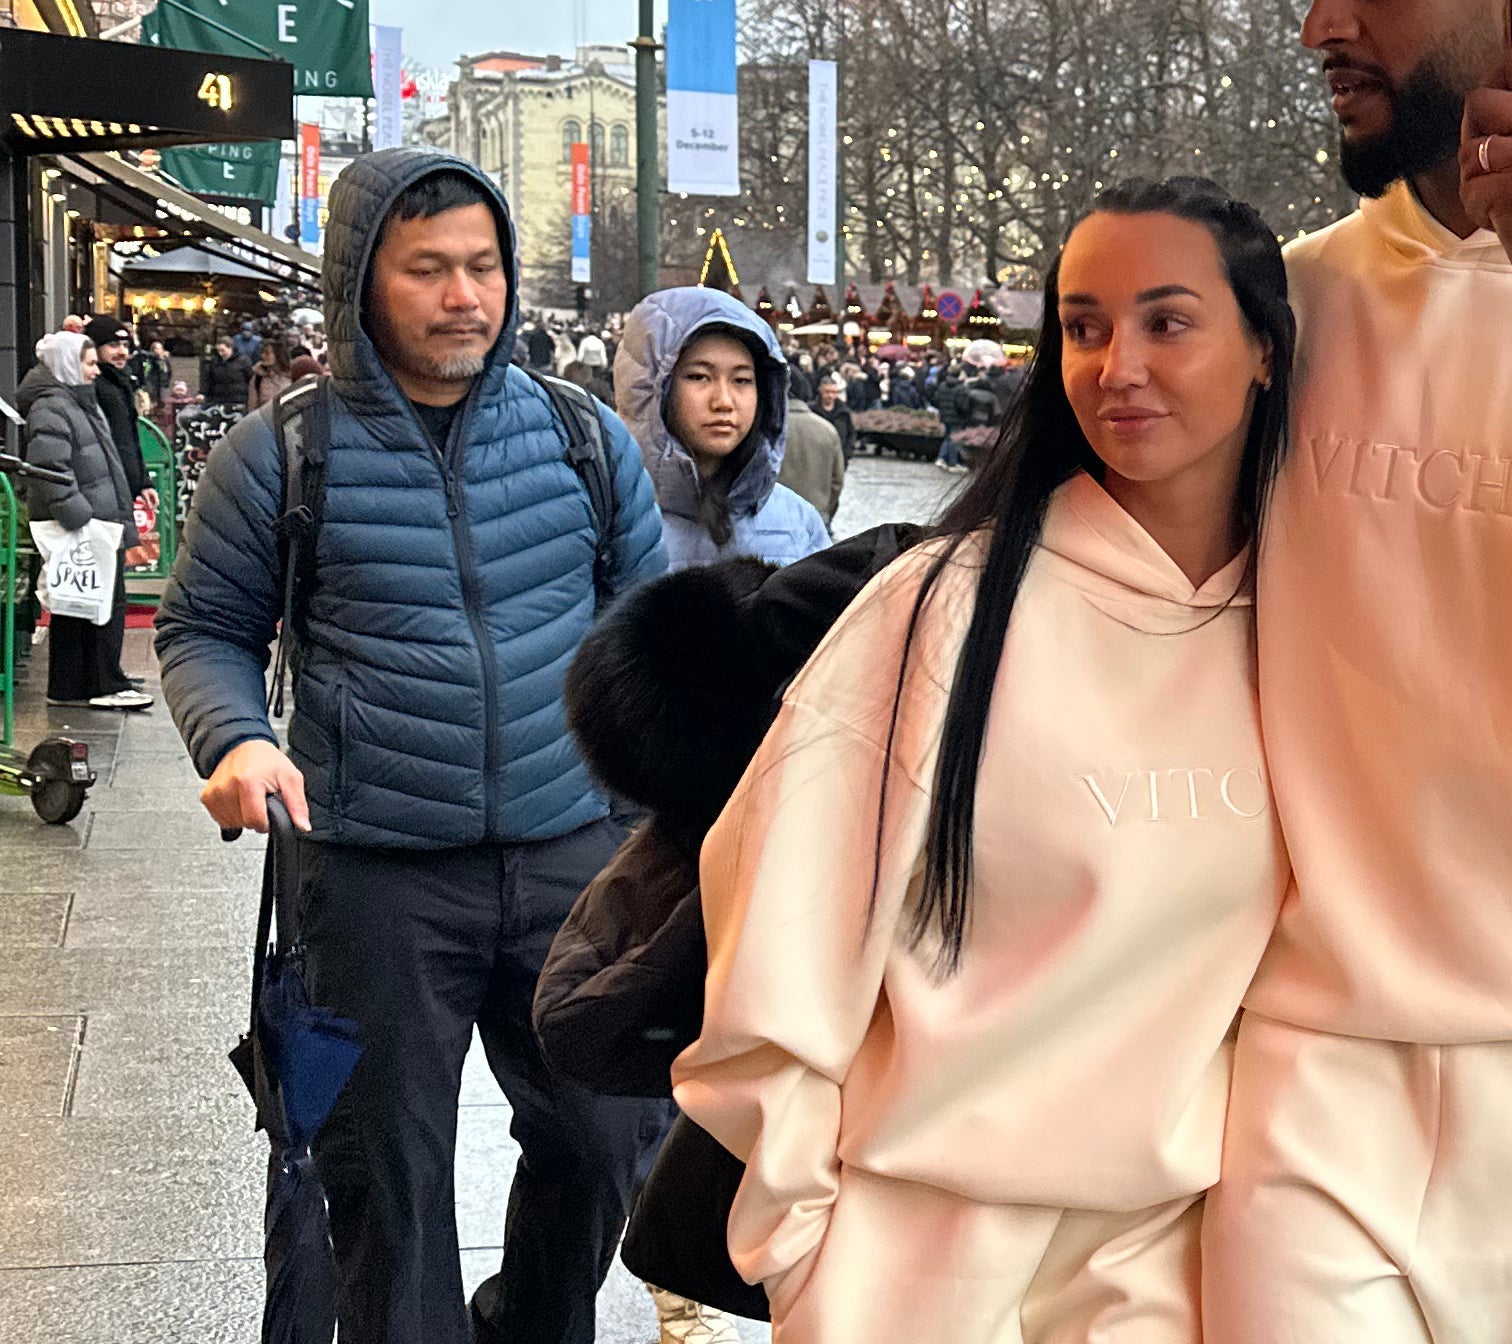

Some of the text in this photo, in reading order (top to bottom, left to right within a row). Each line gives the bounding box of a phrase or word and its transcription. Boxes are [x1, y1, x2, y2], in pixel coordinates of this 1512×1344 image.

[197, 72, 232, 111] 41
[382, 116, 394, 147] PEAC
[676, 140, 729, 152] December
[1070, 766, 1268, 827] VITC
